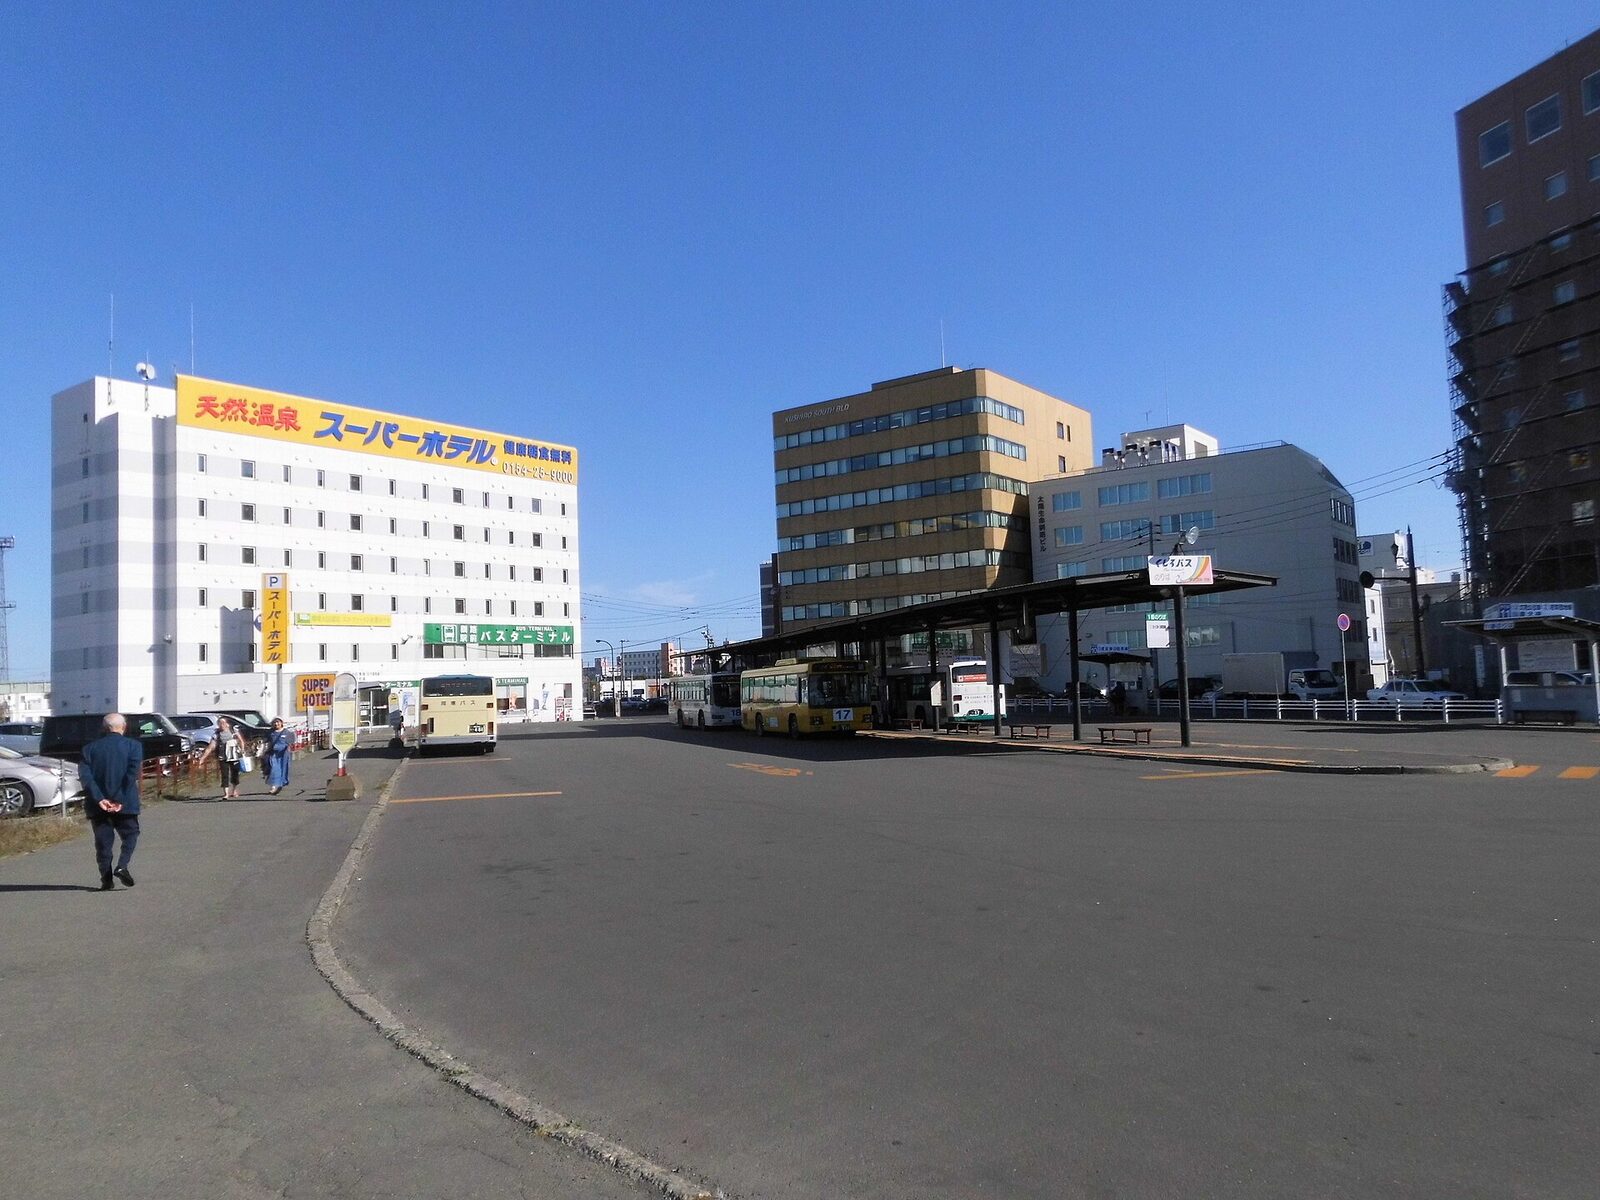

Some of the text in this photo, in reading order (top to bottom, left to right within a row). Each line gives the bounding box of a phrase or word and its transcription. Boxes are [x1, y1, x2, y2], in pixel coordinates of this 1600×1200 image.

[195, 396, 497, 464] 天然温泉 スーパーホテル
[503, 440, 572, 465] 健康朝食無料
[502, 461, 573, 484] 0154-25-9000
[1155, 558, 1192, 568] くしろバス
[269, 576, 279, 587] P
[267, 591, 281, 662] スーパーホテル
[480, 630, 571, 643] バスターミナル
[302, 678, 330, 692] SUPER
[835, 709, 851, 720] 17
